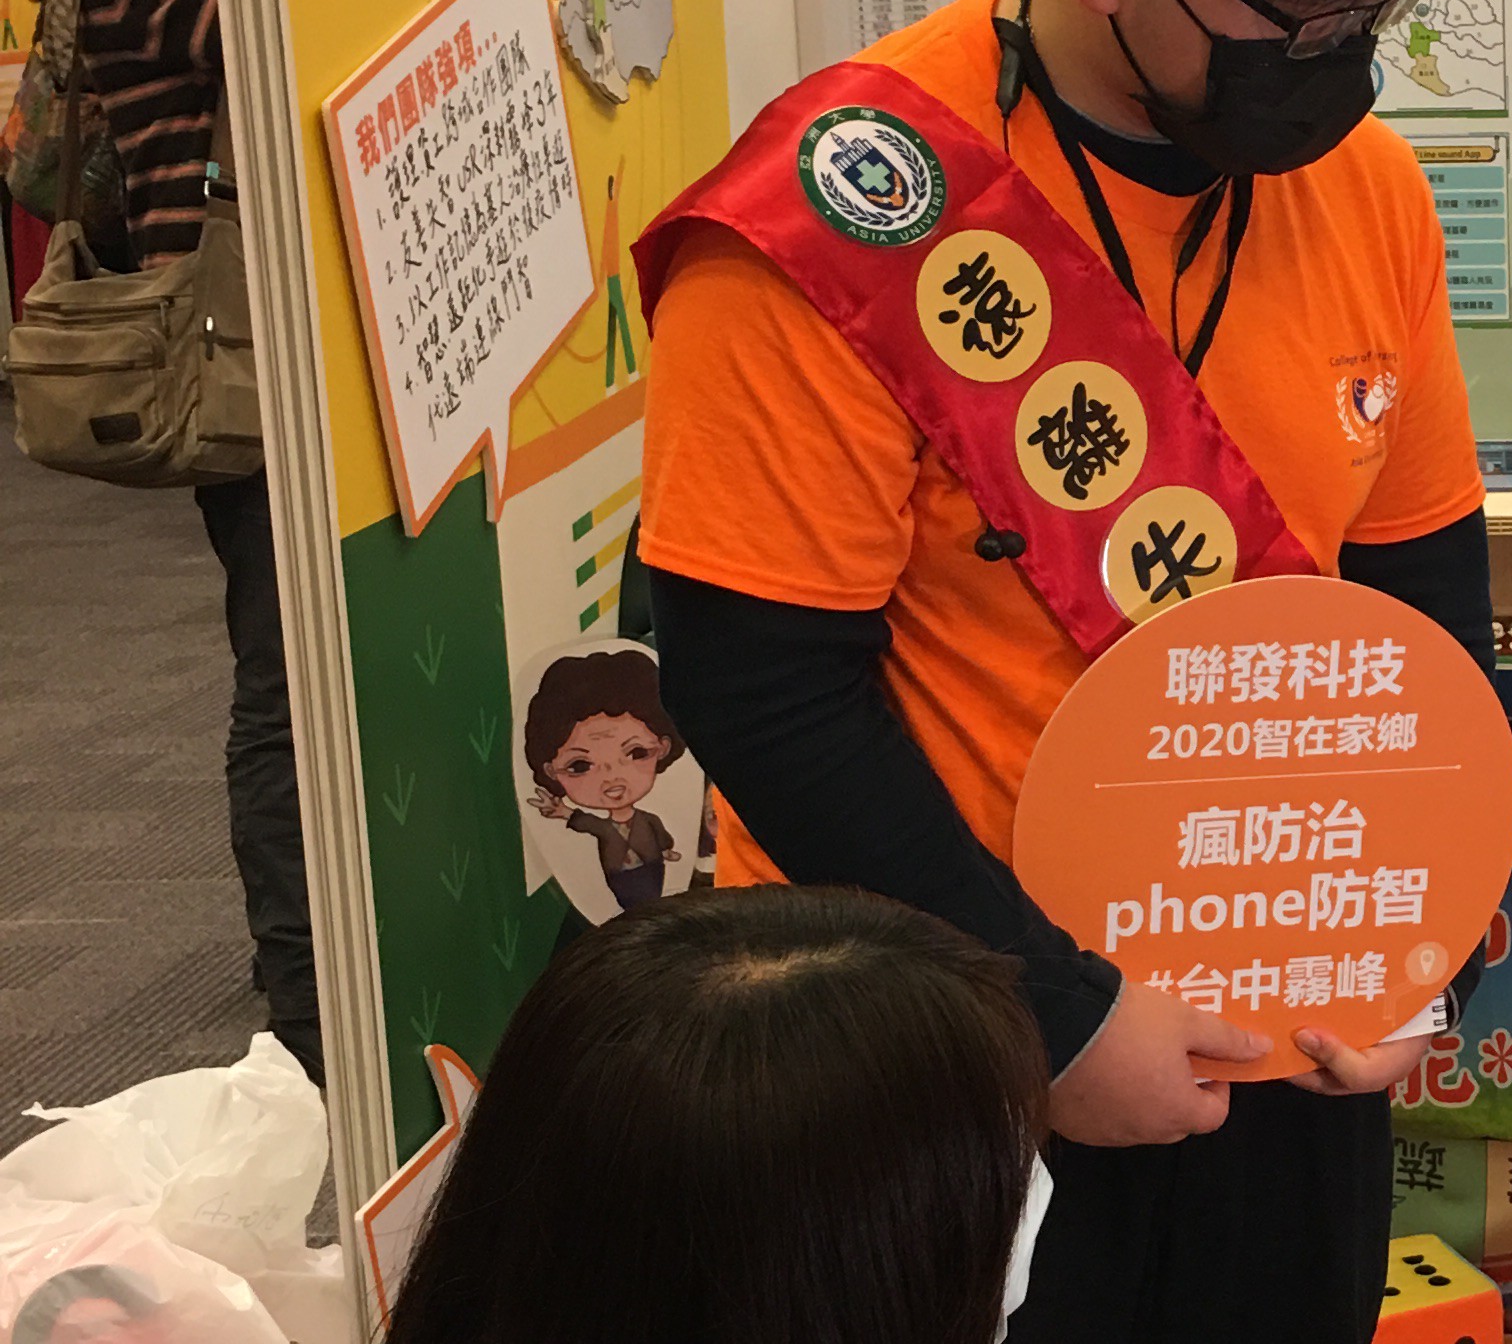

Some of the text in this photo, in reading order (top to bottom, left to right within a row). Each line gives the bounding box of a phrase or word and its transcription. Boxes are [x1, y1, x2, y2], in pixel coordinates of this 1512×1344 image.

[847, 158, 944, 243] ASIA UNIVERSITY
[1165, 638, 1407, 705] 聯發科技
[1146, 712, 1419, 760] 2020智在家鄉
[1177, 799, 1367, 870] 瘋防治
[1106, 866, 1430, 953] phone防智
[1144, 951, 1388, 1014] #台中霧峰
